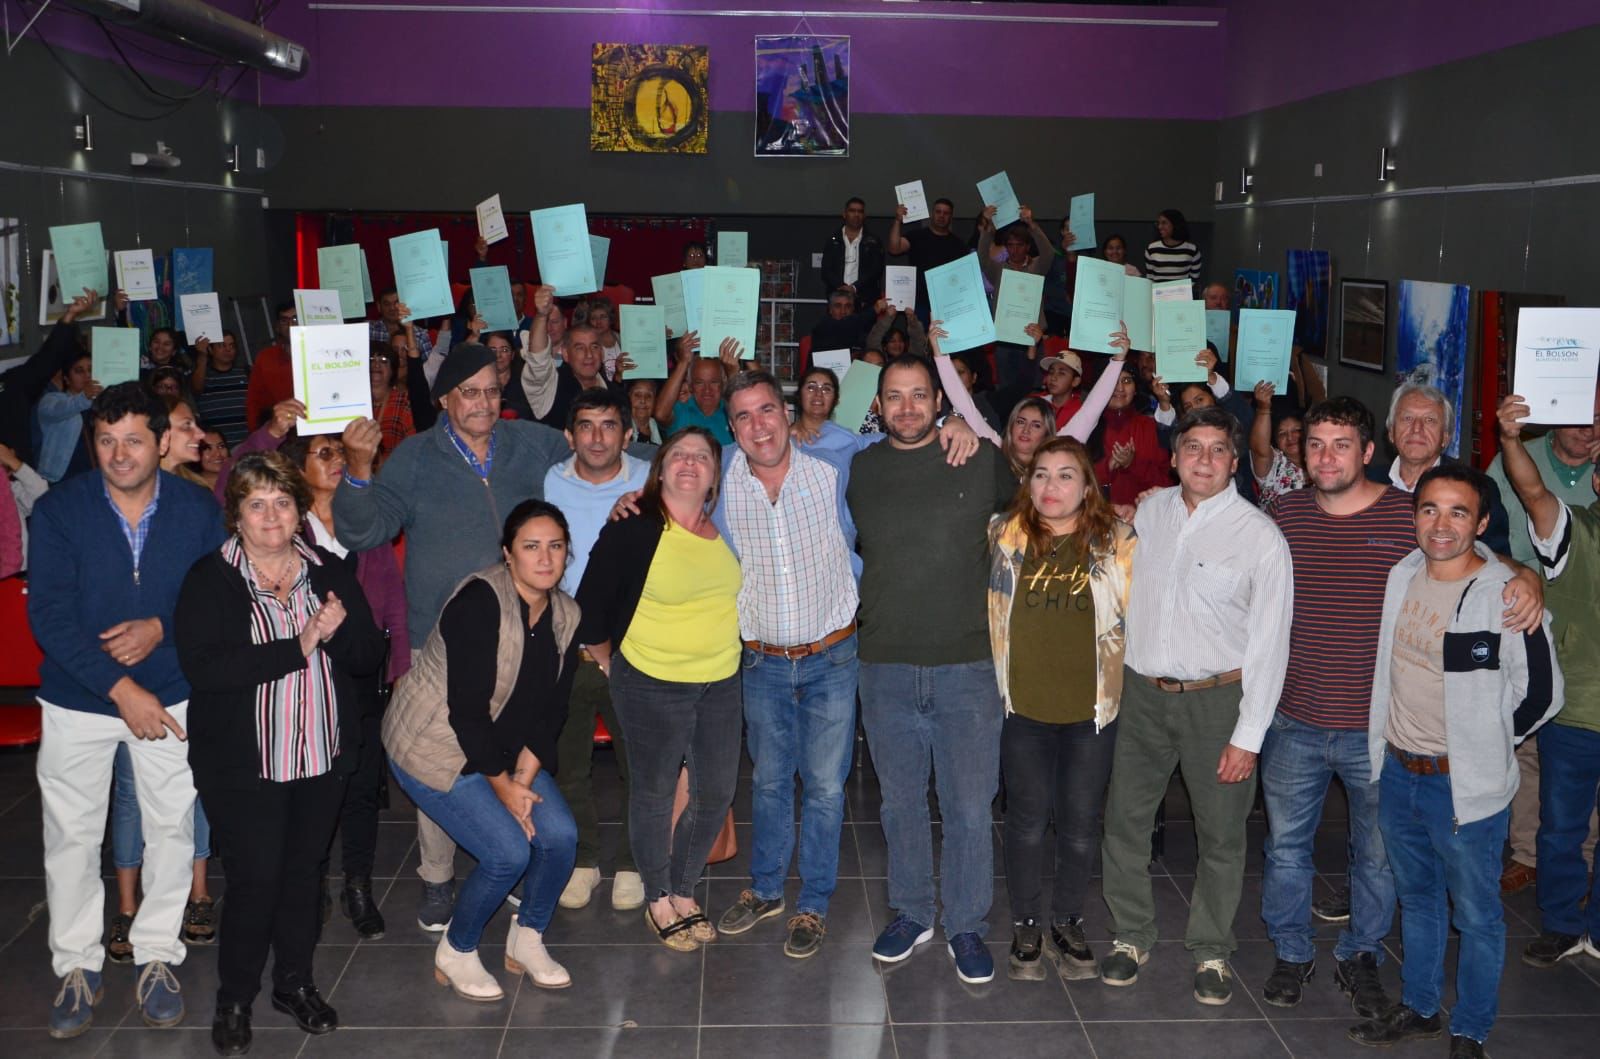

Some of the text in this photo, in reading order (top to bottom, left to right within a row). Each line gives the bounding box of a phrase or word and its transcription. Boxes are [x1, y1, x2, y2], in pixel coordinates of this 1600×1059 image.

[1535, 350, 1543, 358] EL
[311, 362, 321, 370] EL
[1023, 562, 1090, 595] Holy
[1024, 590, 1089, 612] CHIC
[1402, 599, 1447, 638] ARING
